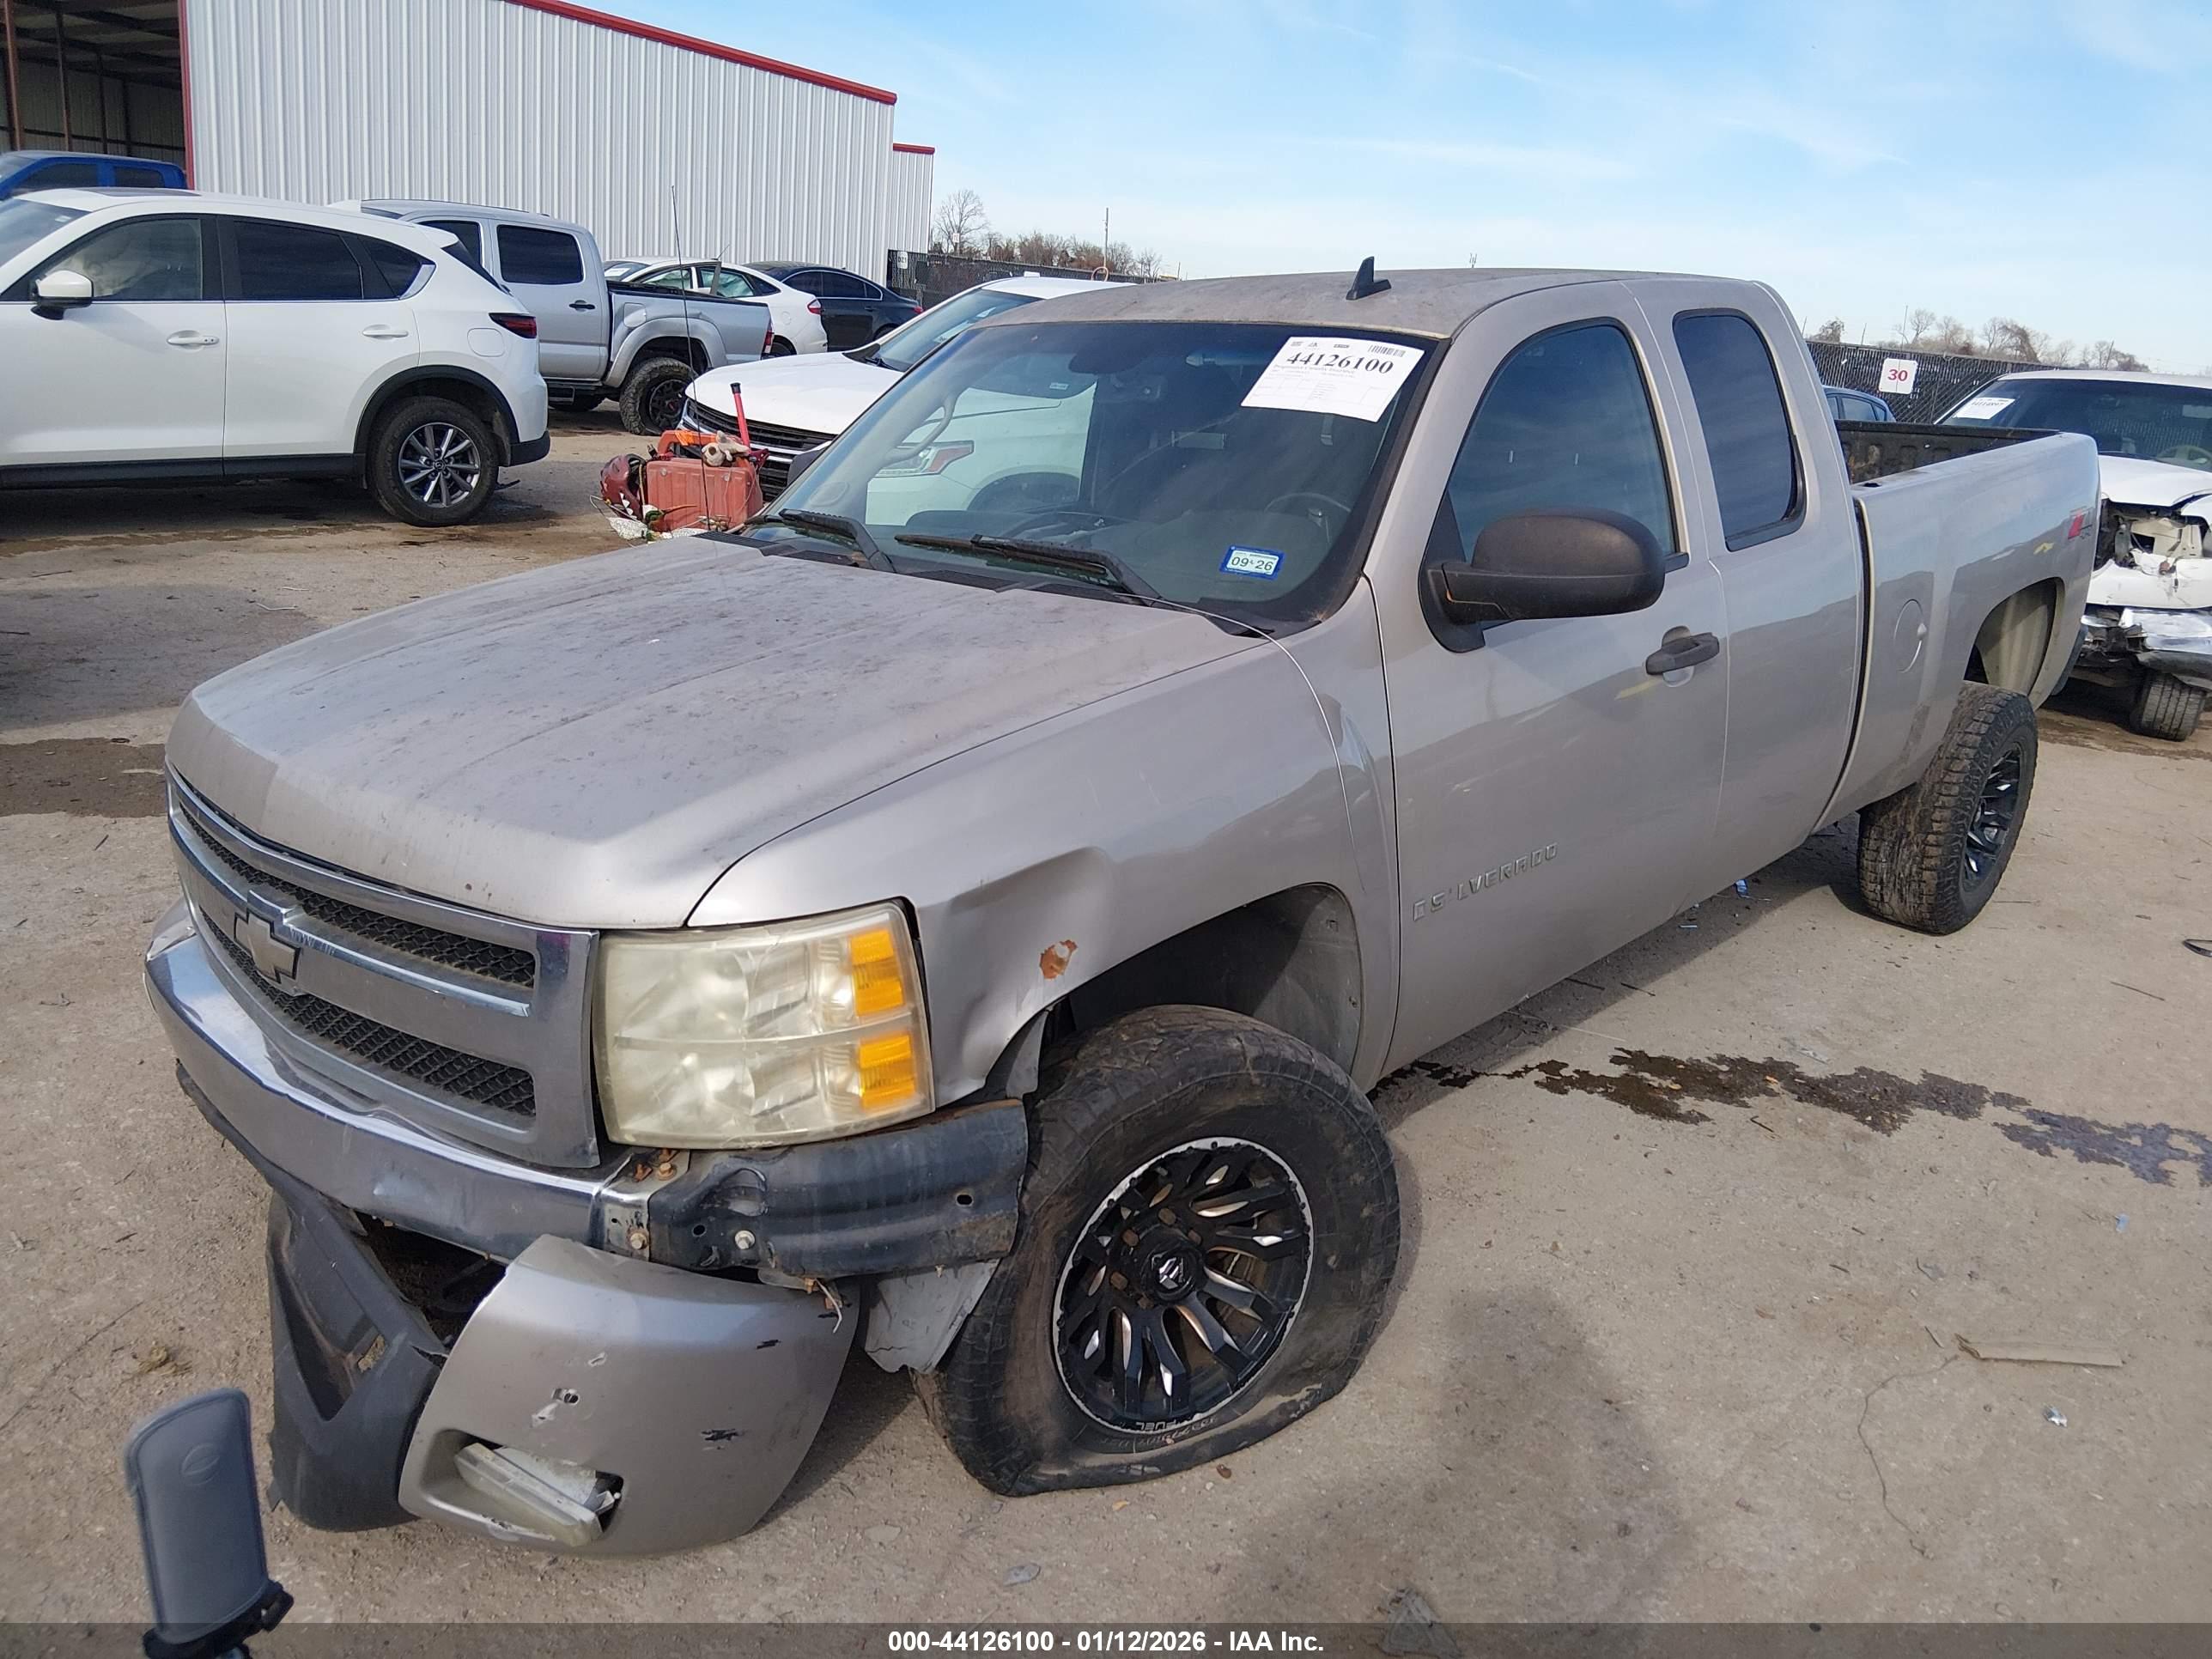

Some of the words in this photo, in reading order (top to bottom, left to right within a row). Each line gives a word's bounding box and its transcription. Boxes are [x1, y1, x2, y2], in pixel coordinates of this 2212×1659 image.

[1286, 351, 1395, 374] 44126100
[1887, 368, 1908, 382] 30
[1231, 556, 1249, 567] 09
[1255, 560, 1273, 571] 26
